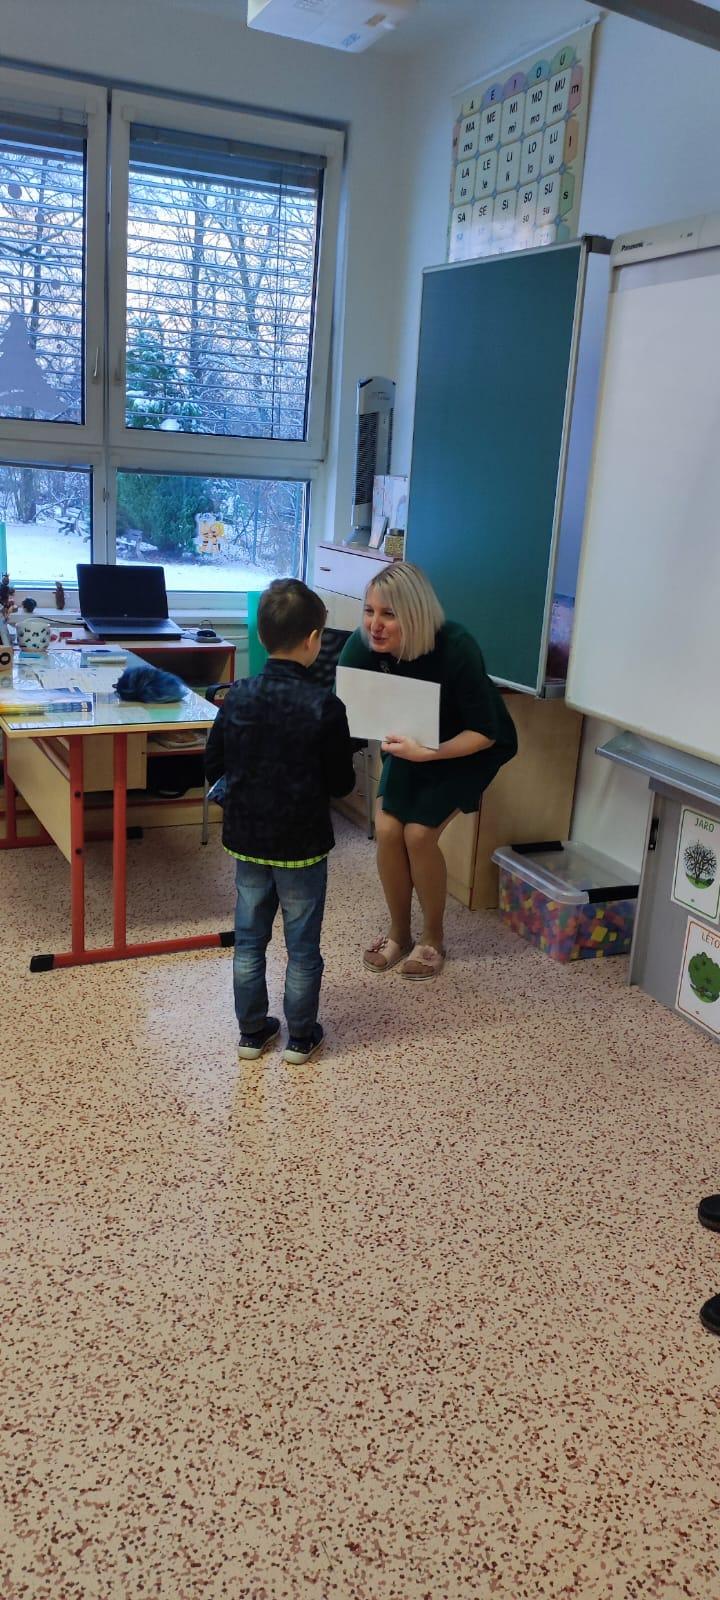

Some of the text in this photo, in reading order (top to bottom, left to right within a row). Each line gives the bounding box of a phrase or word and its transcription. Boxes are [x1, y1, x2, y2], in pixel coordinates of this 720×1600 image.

[490, 89, 496, 100] E
[536, 67, 542, 78] O
[560, 54, 566, 66] U
[571, 84, 579, 93] m
[465, 78, 566, 133] MA ME MI MO MU
[530, 114, 540, 125] mo
[461, 131, 559, 179] LA LE LI LO LU
[457, 213, 466, 223] SA
[478, 205, 488, 217] SE
[523, 191, 533, 204] SO
[544, 182, 554, 195] SU
[694, 818, 715, 833] JARO
